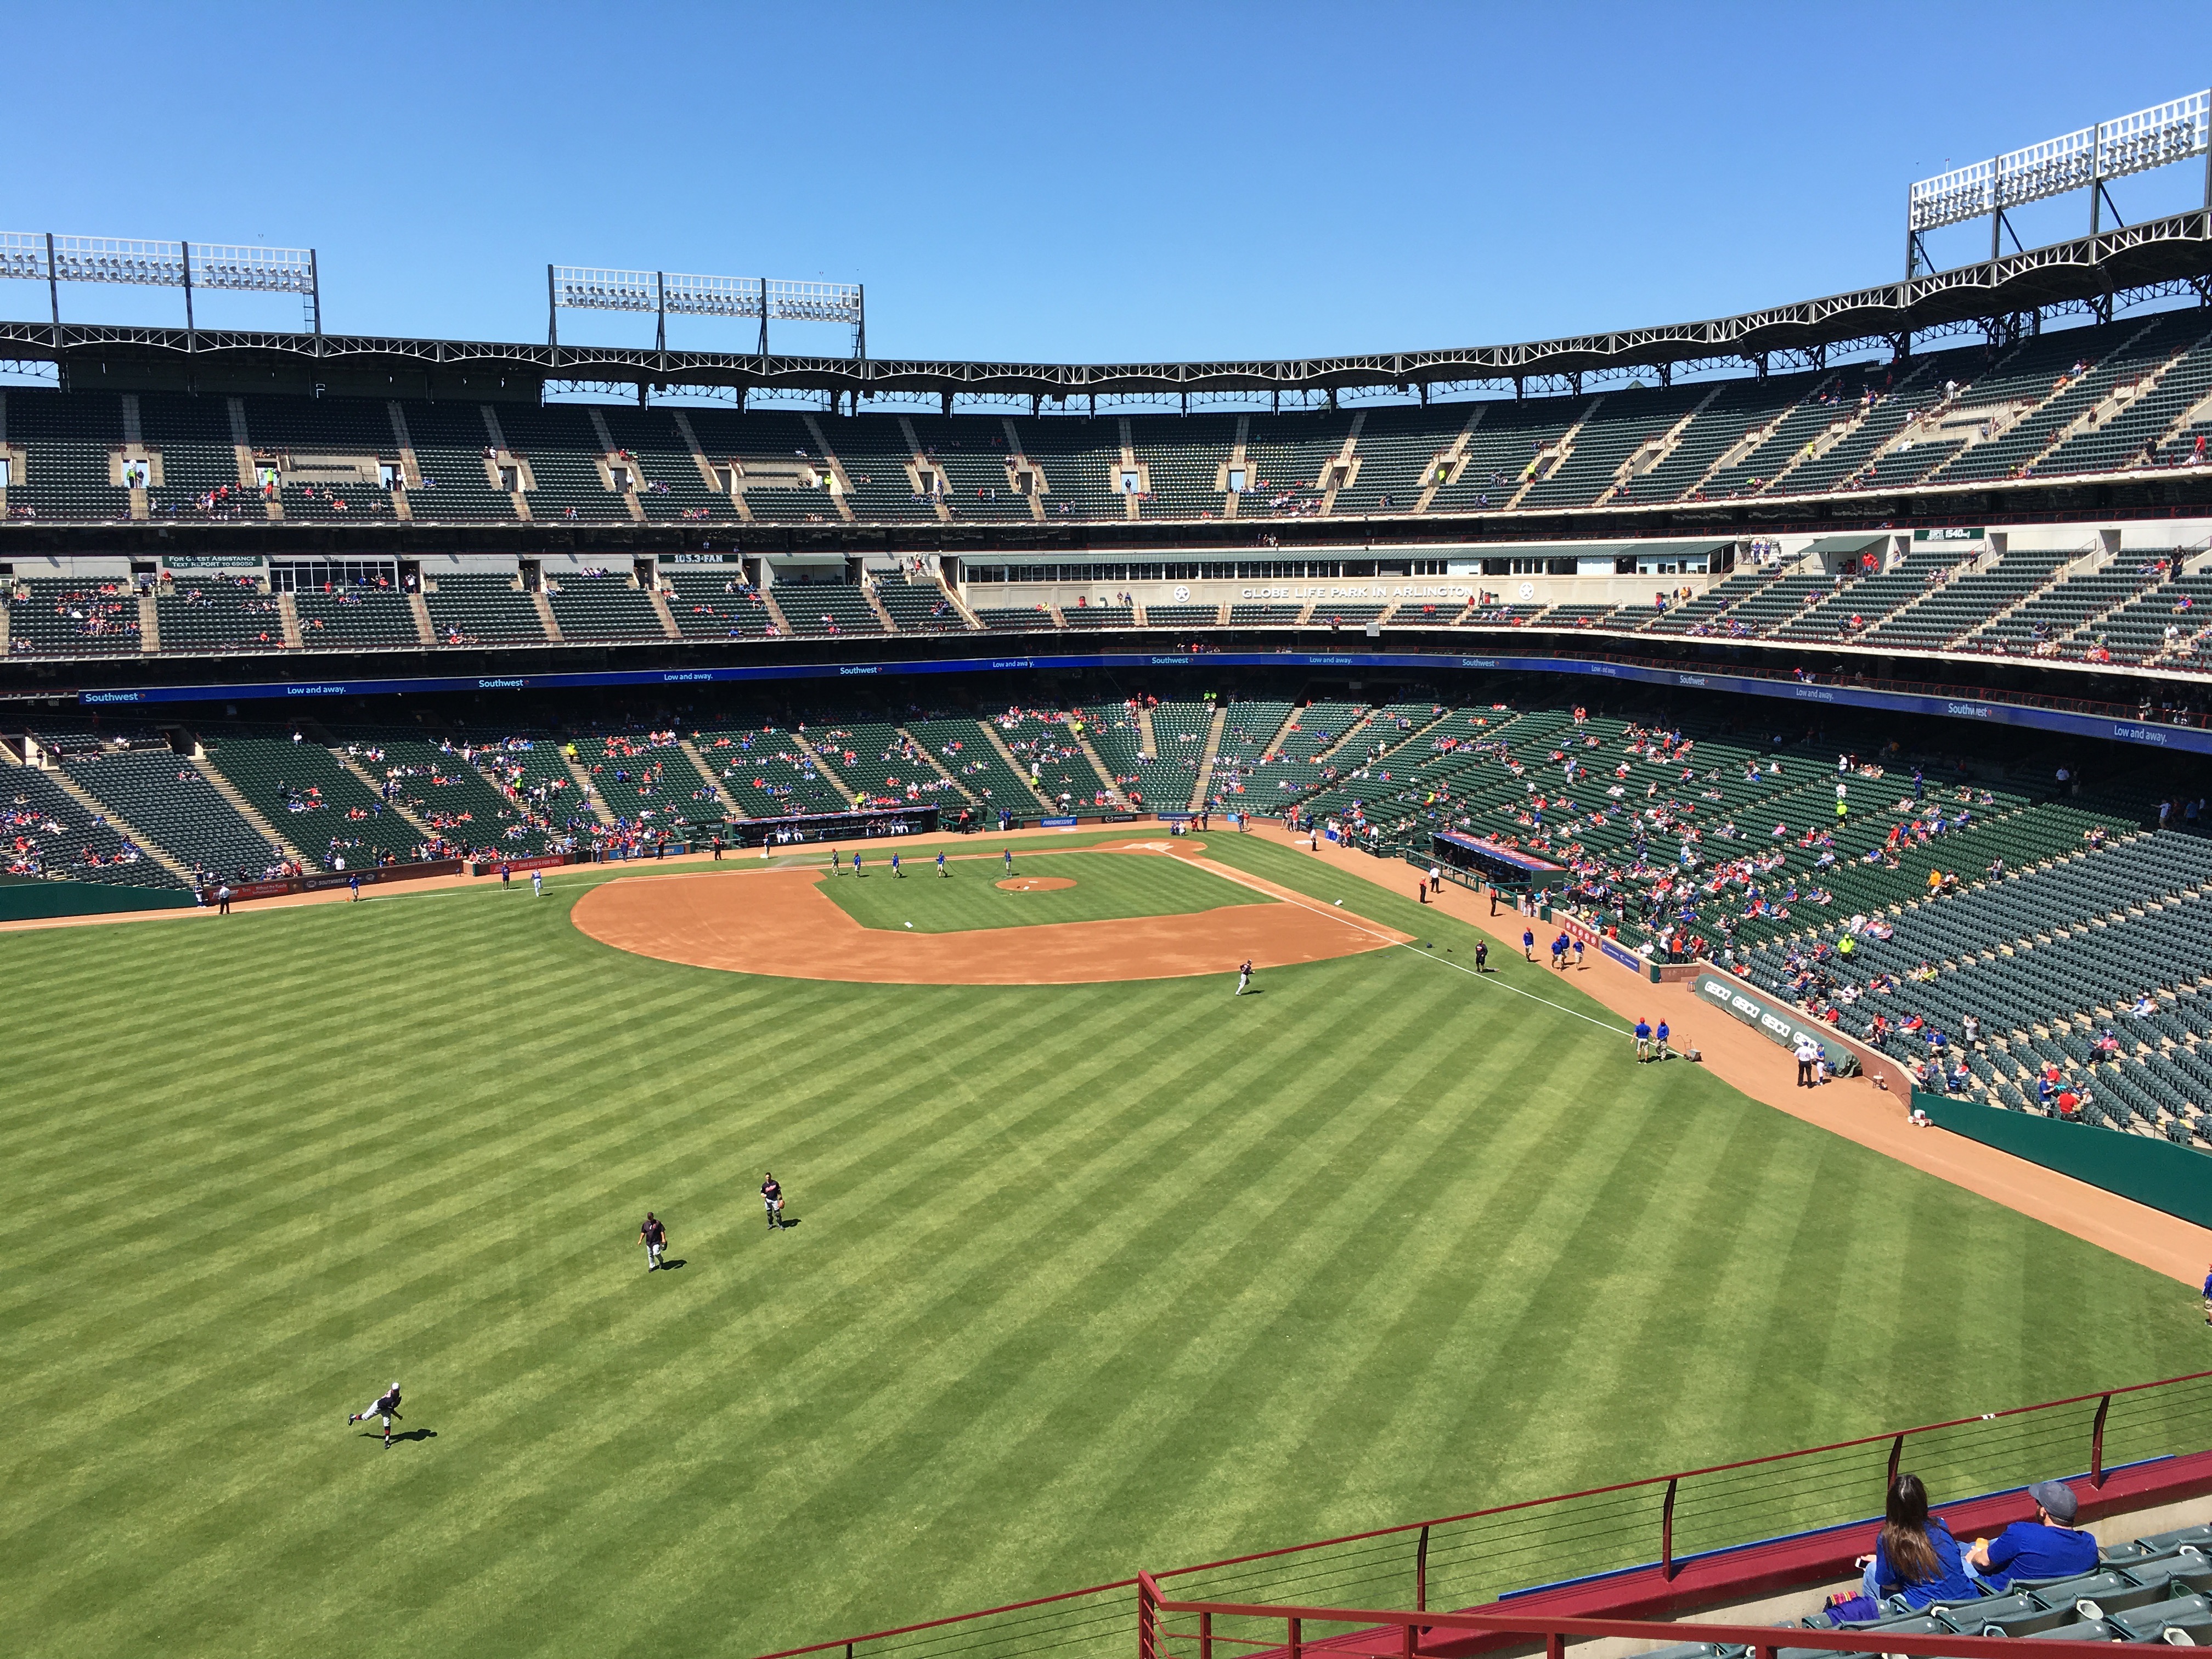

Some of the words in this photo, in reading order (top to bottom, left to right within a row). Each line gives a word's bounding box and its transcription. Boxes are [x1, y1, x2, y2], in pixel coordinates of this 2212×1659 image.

[1945, 529, 1963, 538] 1540
[674, 554, 701, 563] 105.3
[1242, 588, 1289, 598] GLOBE
[1295, 588, 1325, 597] LIFE
[1331, 587, 1368, 597] PARK
[1372, 586, 1387, 597] IN
[1393, 586, 1474, 596] ARLINGTON
[840, 666, 877, 674] Southwest
[478, 679, 524, 687] Southwest
[1680, 675, 1705, 686] Southwest
[323, 686, 346, 695] away.
[1796, 687, 1808, 696] Low
[1808, 689, 1818, 698] and
[1818, 692, 1834, 702] away.
[85, 692, 138, 702] Southwest
[1948, 702, 1988, 718] Southwest
[2114, 725, 2130, 737] Low
[2130, 728, 2145, 739] and
[2146, 731, 2167, 745] away.
[318, 877, 347, 886] SOUTHWEST
[1704, 981, 1732, 1001] GEICO
[1732, 996, 1760, 1018] GEICO
[1761, 1013, 1791, 1037] GEICO
